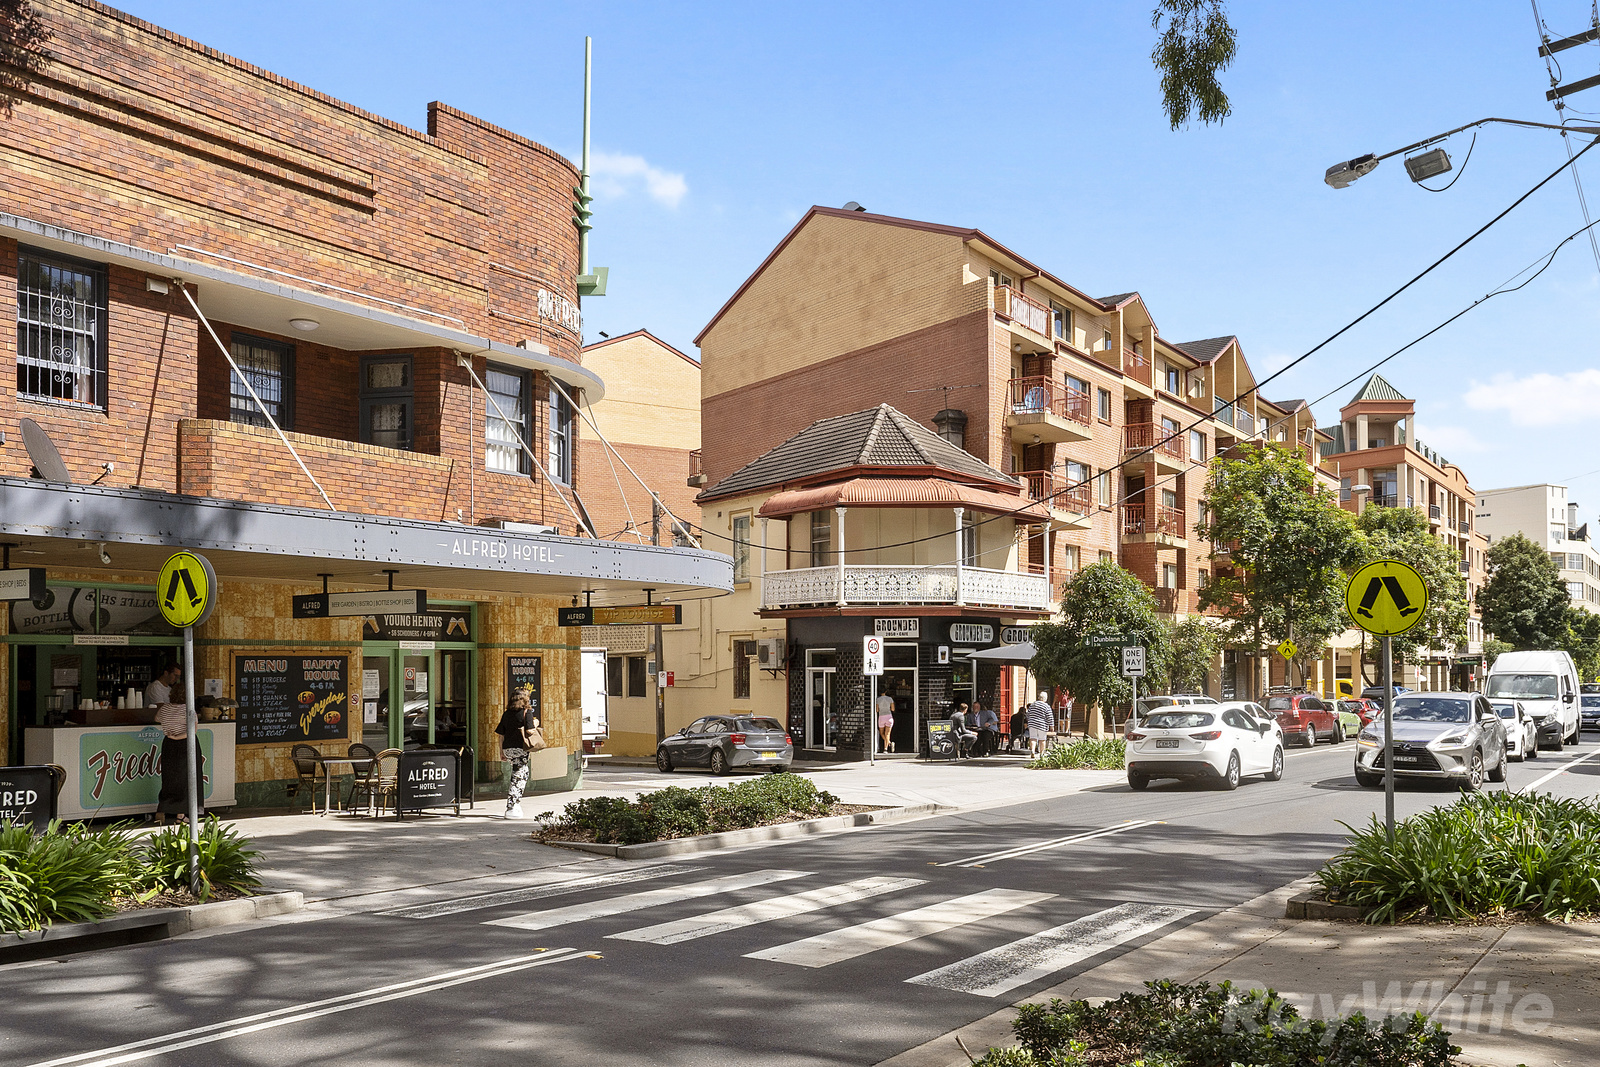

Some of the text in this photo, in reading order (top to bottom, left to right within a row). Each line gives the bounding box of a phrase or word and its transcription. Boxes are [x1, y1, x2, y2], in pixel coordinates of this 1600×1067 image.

[452, 538, 554, 562] ALFRED HOTEL
[604, 610, 664, 619] VIP LOUNGE
[384, 615, 442, 627] YOUNG HENRYS
[876, 620, 917, 631] GROUNDED
[955, 625, 982, 641] GROUNDED
[244, 660, 288, 672] MENU
[302, 660, 341, 669] HAPPY
[304, 671, 340, 680] HOUR
[513, 667, 535, 675] HOUR
[300, 692, 346, 735] Everyday
[408, 768, 448, 781] ALFRED
[0, 790, 38, 806] RED
